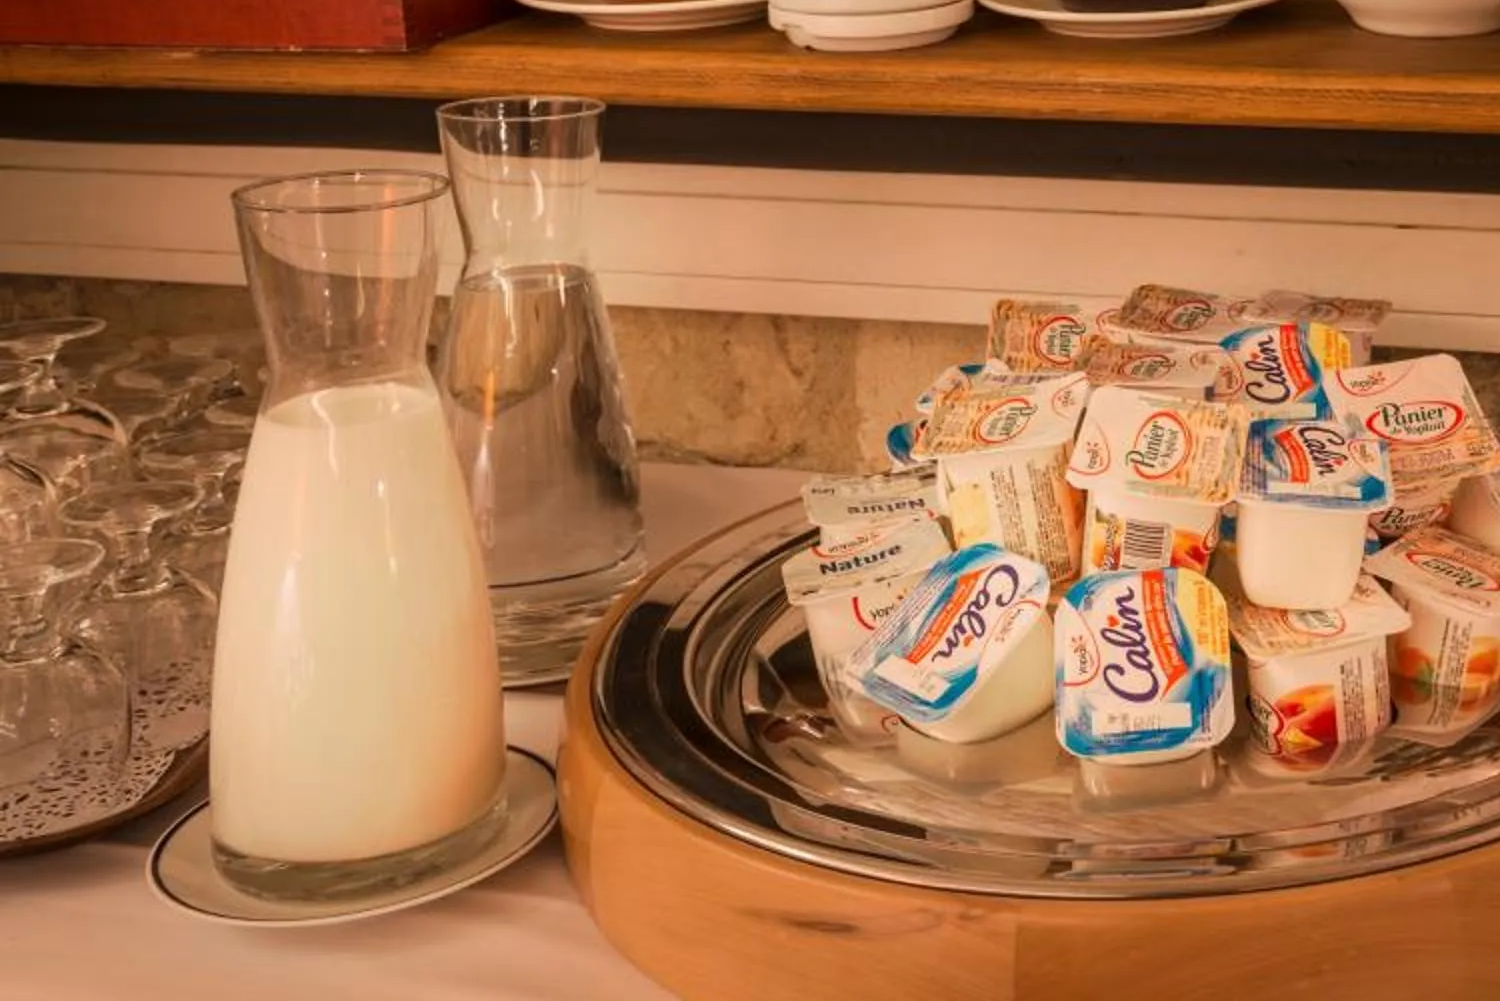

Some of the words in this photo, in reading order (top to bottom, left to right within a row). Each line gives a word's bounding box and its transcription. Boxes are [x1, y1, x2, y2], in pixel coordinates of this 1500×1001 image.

[1375, 401, 1448, 427] Panier
[1125, 420, 1165, 469] Panier
[847, 498, 926, 514] Nature
[818, 544, 903, 576] Nature
[931, 563, 1020, 663] Calin
[1099, 586, 1160, 703] Calin
